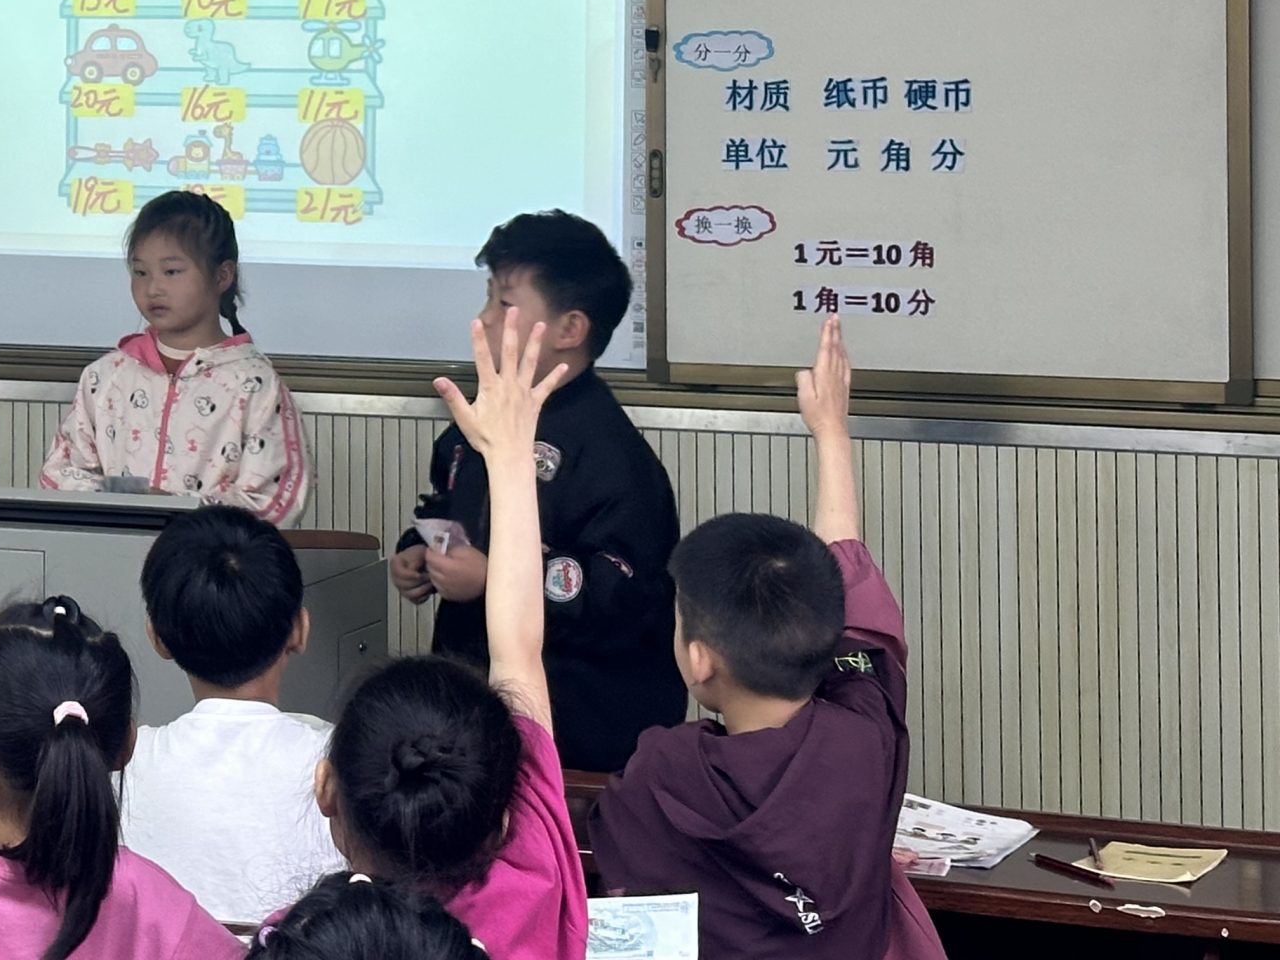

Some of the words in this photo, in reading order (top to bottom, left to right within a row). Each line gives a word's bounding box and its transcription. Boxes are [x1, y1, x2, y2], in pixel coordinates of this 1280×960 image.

[694, 42, 751, 62] 分一分
[71, 86, 123, 117] 20元
[182, 84, 234, 121] 16元
[301, 91, 355, 121] 11元
[726, 79, 790, 111] 材质
[824, 78, 888, 110] 纸币
[904, 78, 972, 111] 硬币
[722, 140, 788, 170] 单位
[827, 140, 859, 170] 元
[881, 140, 910, 171] 角
[931, 140, 965, 171] 分
[75, 178, 121, 214] 19元
[300, 191, 362, 225] 21元
[694, 215, 752, 235] 换一换
